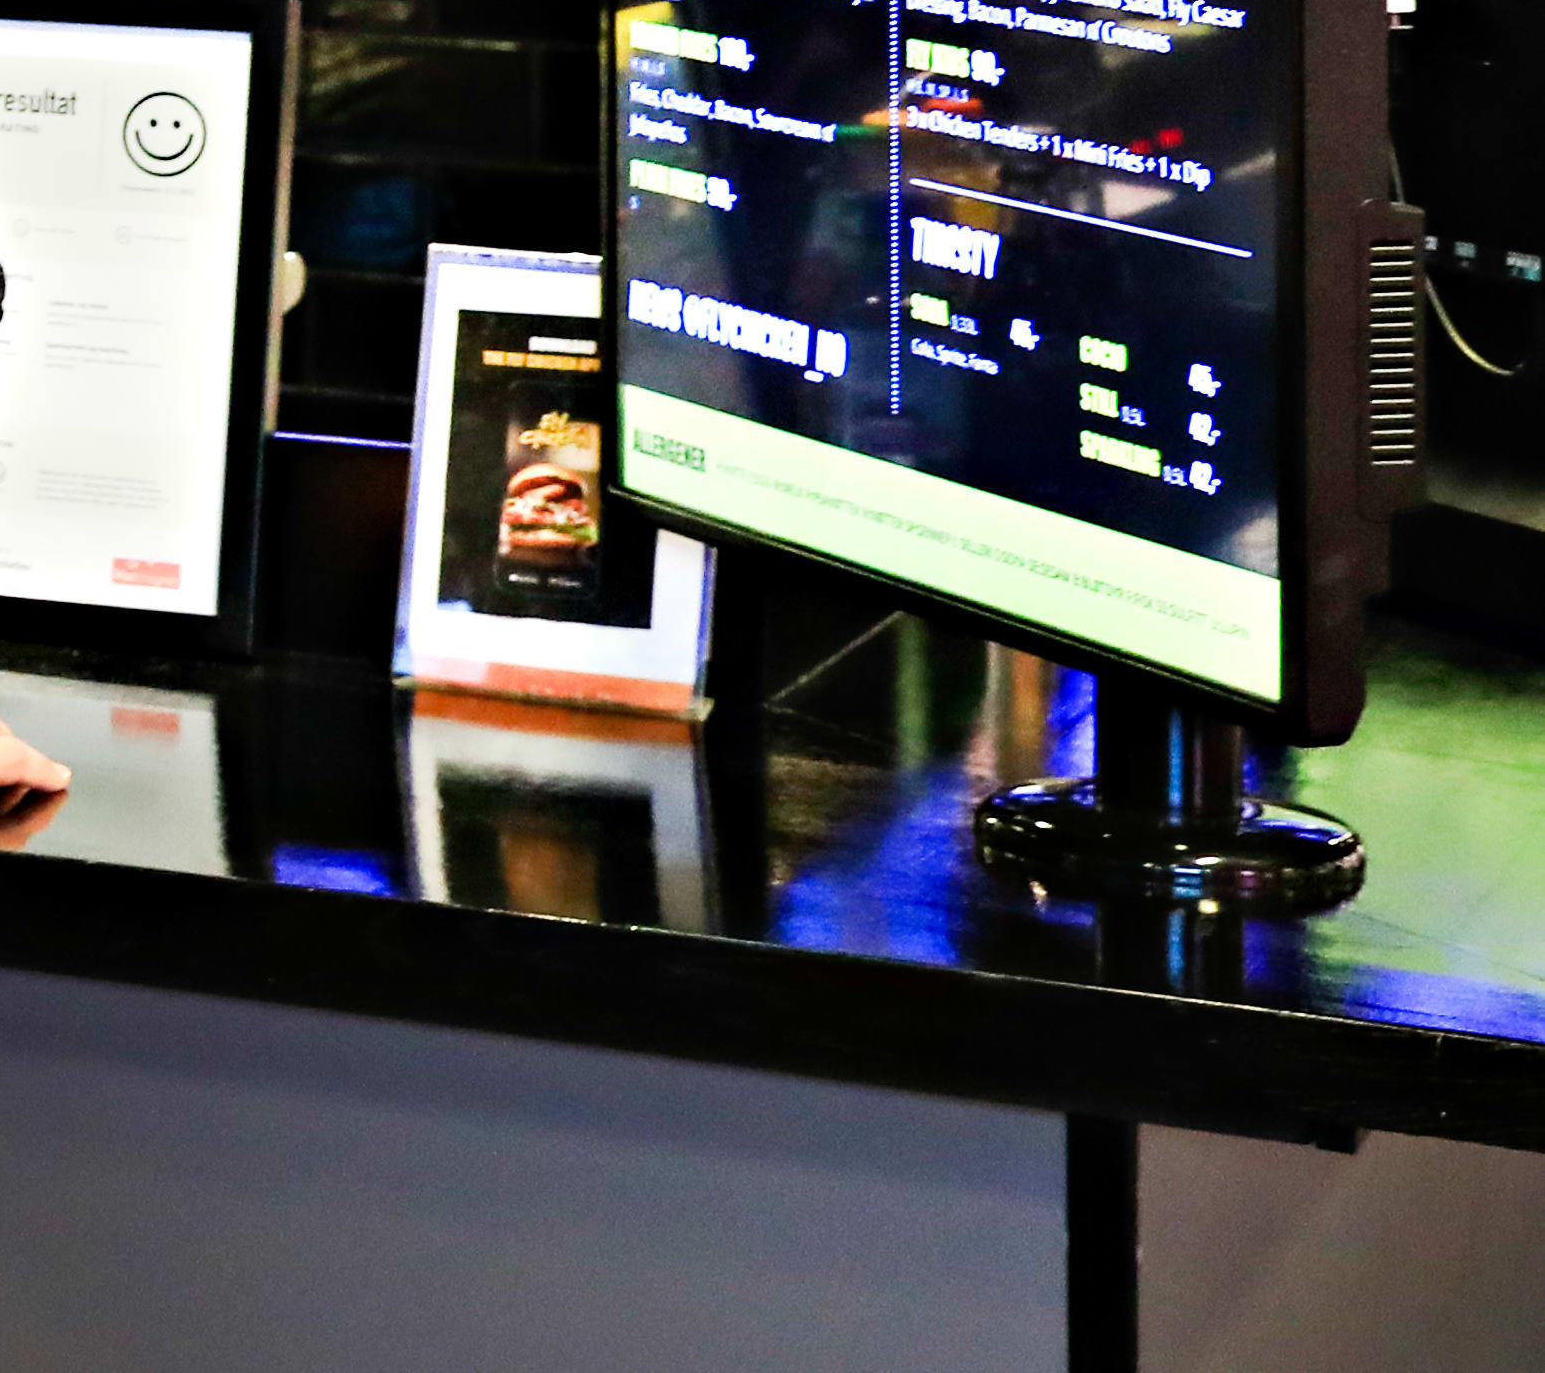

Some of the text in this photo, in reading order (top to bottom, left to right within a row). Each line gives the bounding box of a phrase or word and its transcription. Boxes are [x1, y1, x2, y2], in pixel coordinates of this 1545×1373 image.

[1192, 0, 1247, 29] Caesar
[928, 108, 983, 140] Chicken
[1108, 144, 1145, 173] Fries
[1183, 159, 1214, 192] Dip
[910, 216, 1002, 280] THIRSTY
[627, 278, 683, 334] NEWS
[1079, 382, 1119, 418] STILL
